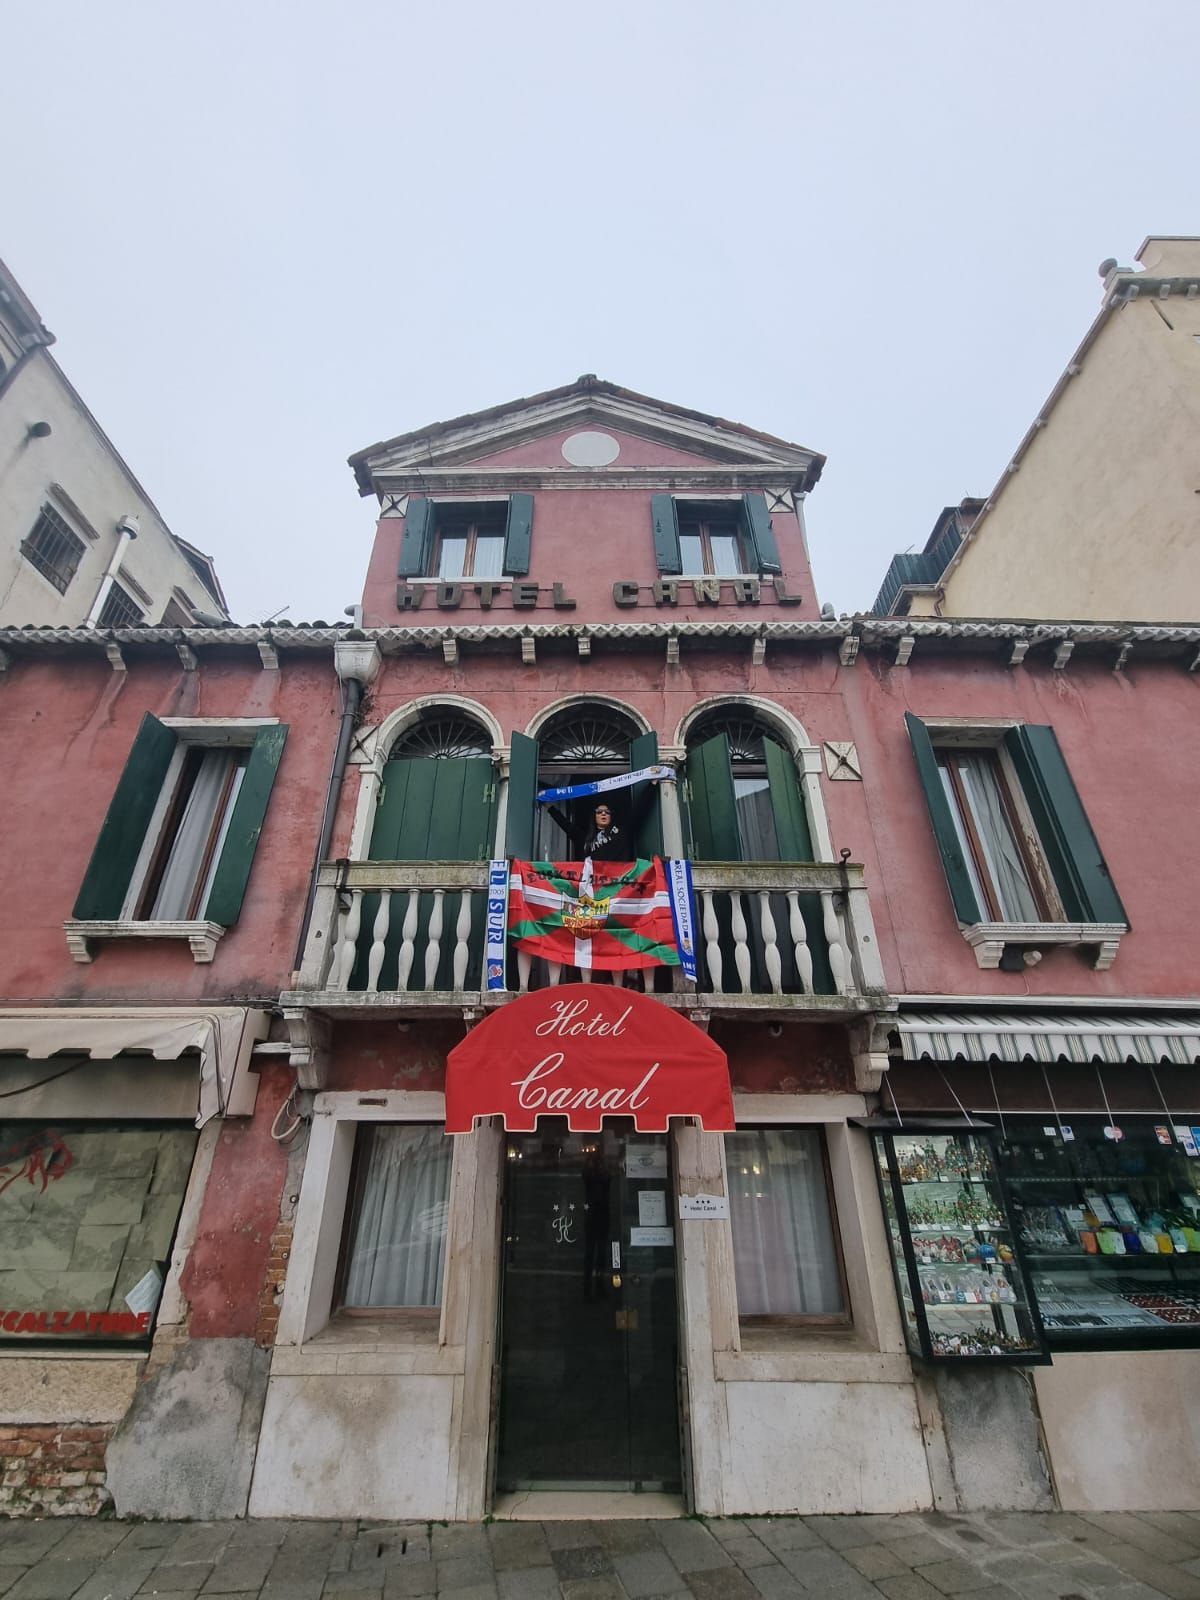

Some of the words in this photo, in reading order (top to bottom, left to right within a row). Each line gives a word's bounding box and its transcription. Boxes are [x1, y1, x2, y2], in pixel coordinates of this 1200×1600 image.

[397, 582, 576, 610] HOTEL
[613, 577, 801, 607] CANAL
[674, 864, 684, 886] REAL
[488, 902, 503, 941] SUR
[677, 887, 689, 931] SOCIEDAD
[535, 1000, 633, 1037] Hotel
[511, 1052, 660, 1110] Canal
